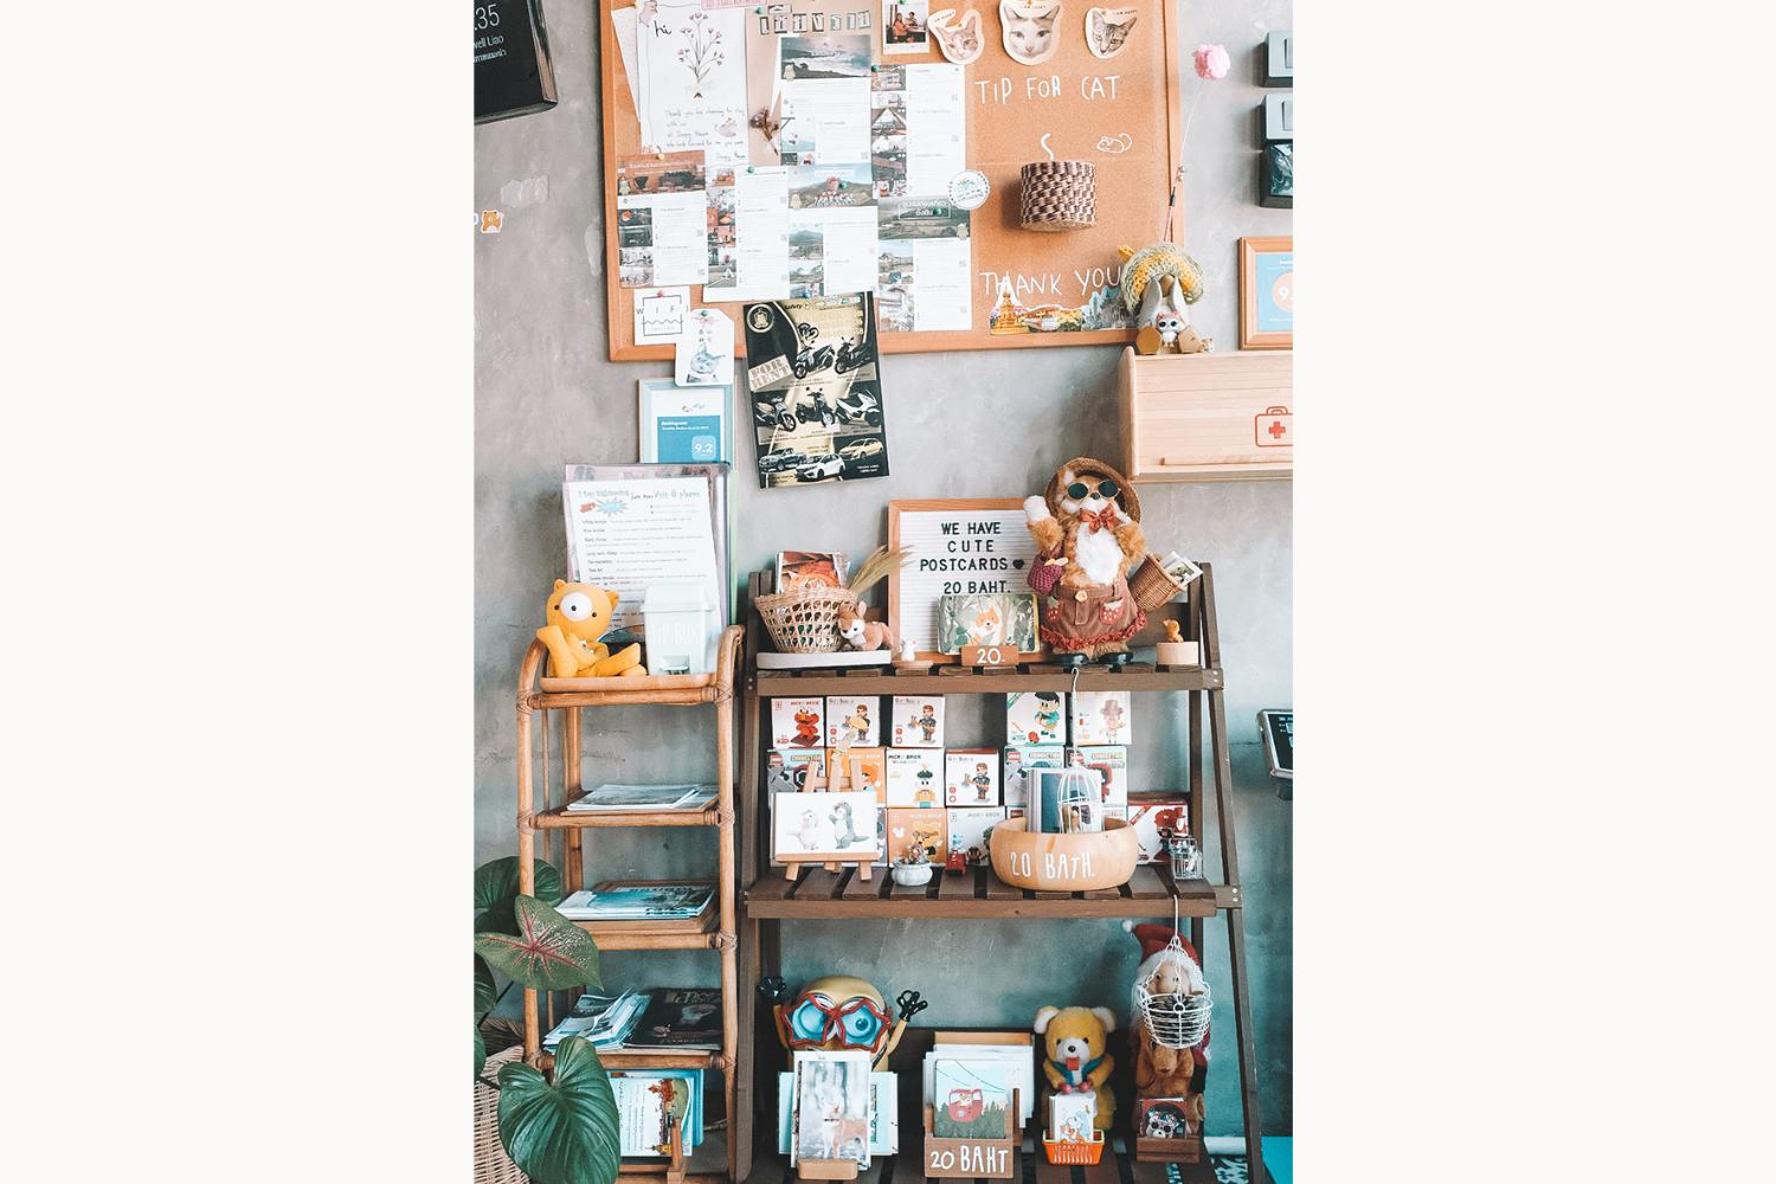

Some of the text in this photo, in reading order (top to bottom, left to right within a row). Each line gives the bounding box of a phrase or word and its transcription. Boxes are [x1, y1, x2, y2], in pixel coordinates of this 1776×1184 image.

[653, 19, 673, 39] hi
[974, 75, 1120, 105] TIP FOR CAT
[979, 265, 1121, 296] THANK YOU
[694, 442, 713, 454] 9.2
[941, 521, 1001, 535] WE HAVE
[947, 540, 994, 552] CUTE
[920, 557, 1008, 571] POSTCARDS
[943, 581, 1011, 594] 20 BAHT.
[1010, 851, 1031, 877] 20
[930, 1144, 1009, 1174] 20 BAHT
